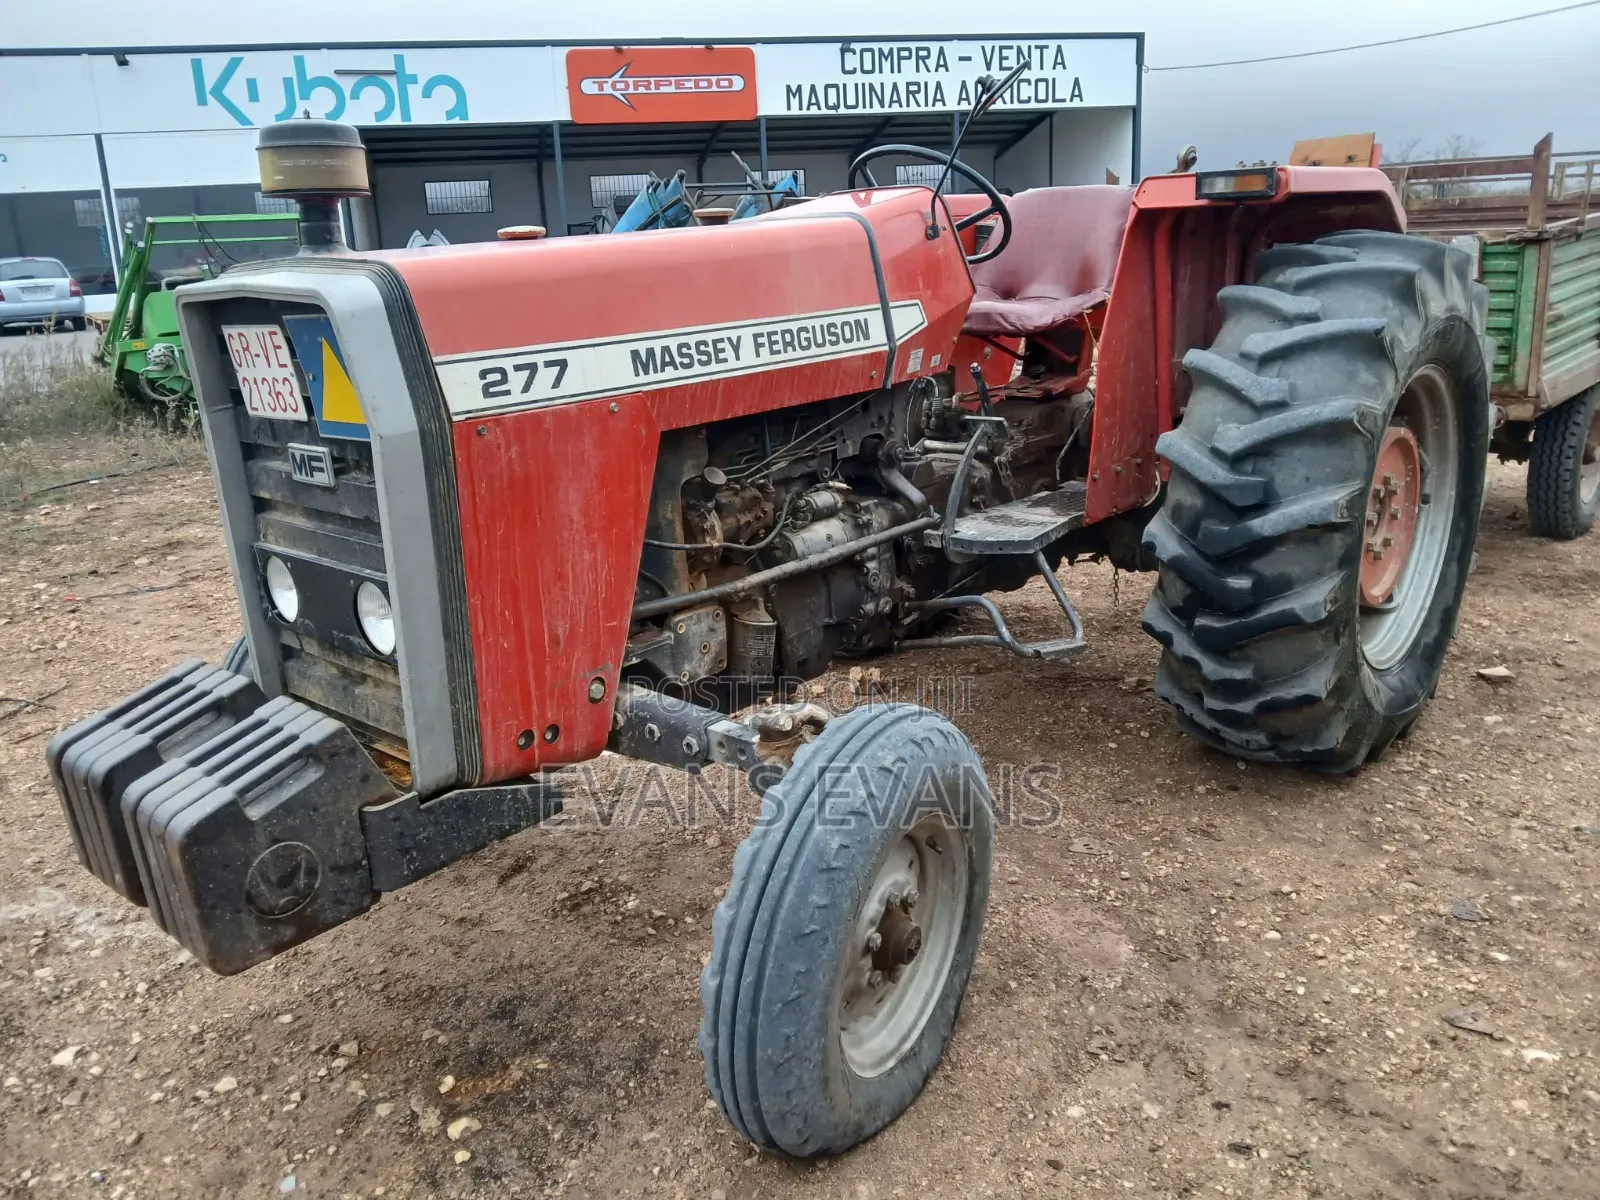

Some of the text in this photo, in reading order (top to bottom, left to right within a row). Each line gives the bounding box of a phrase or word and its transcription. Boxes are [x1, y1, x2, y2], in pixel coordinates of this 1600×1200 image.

[841, 46, 949, 75] COMPRA
[981, 44, 1067, 71] VENTA
[190, 54, 469, 126] Kubota
[592, 77, 734, 92] TORPEDO
[786, 77, 1084, 113] MAQUINARIA AICOLA
[227, 331, 288, 368] GR-VE
[479, 318, 870, 399] 277 MASSEY FERGUSON
[242, 377, 298, 413] 21363
[290, 452, 325, 478] MF
